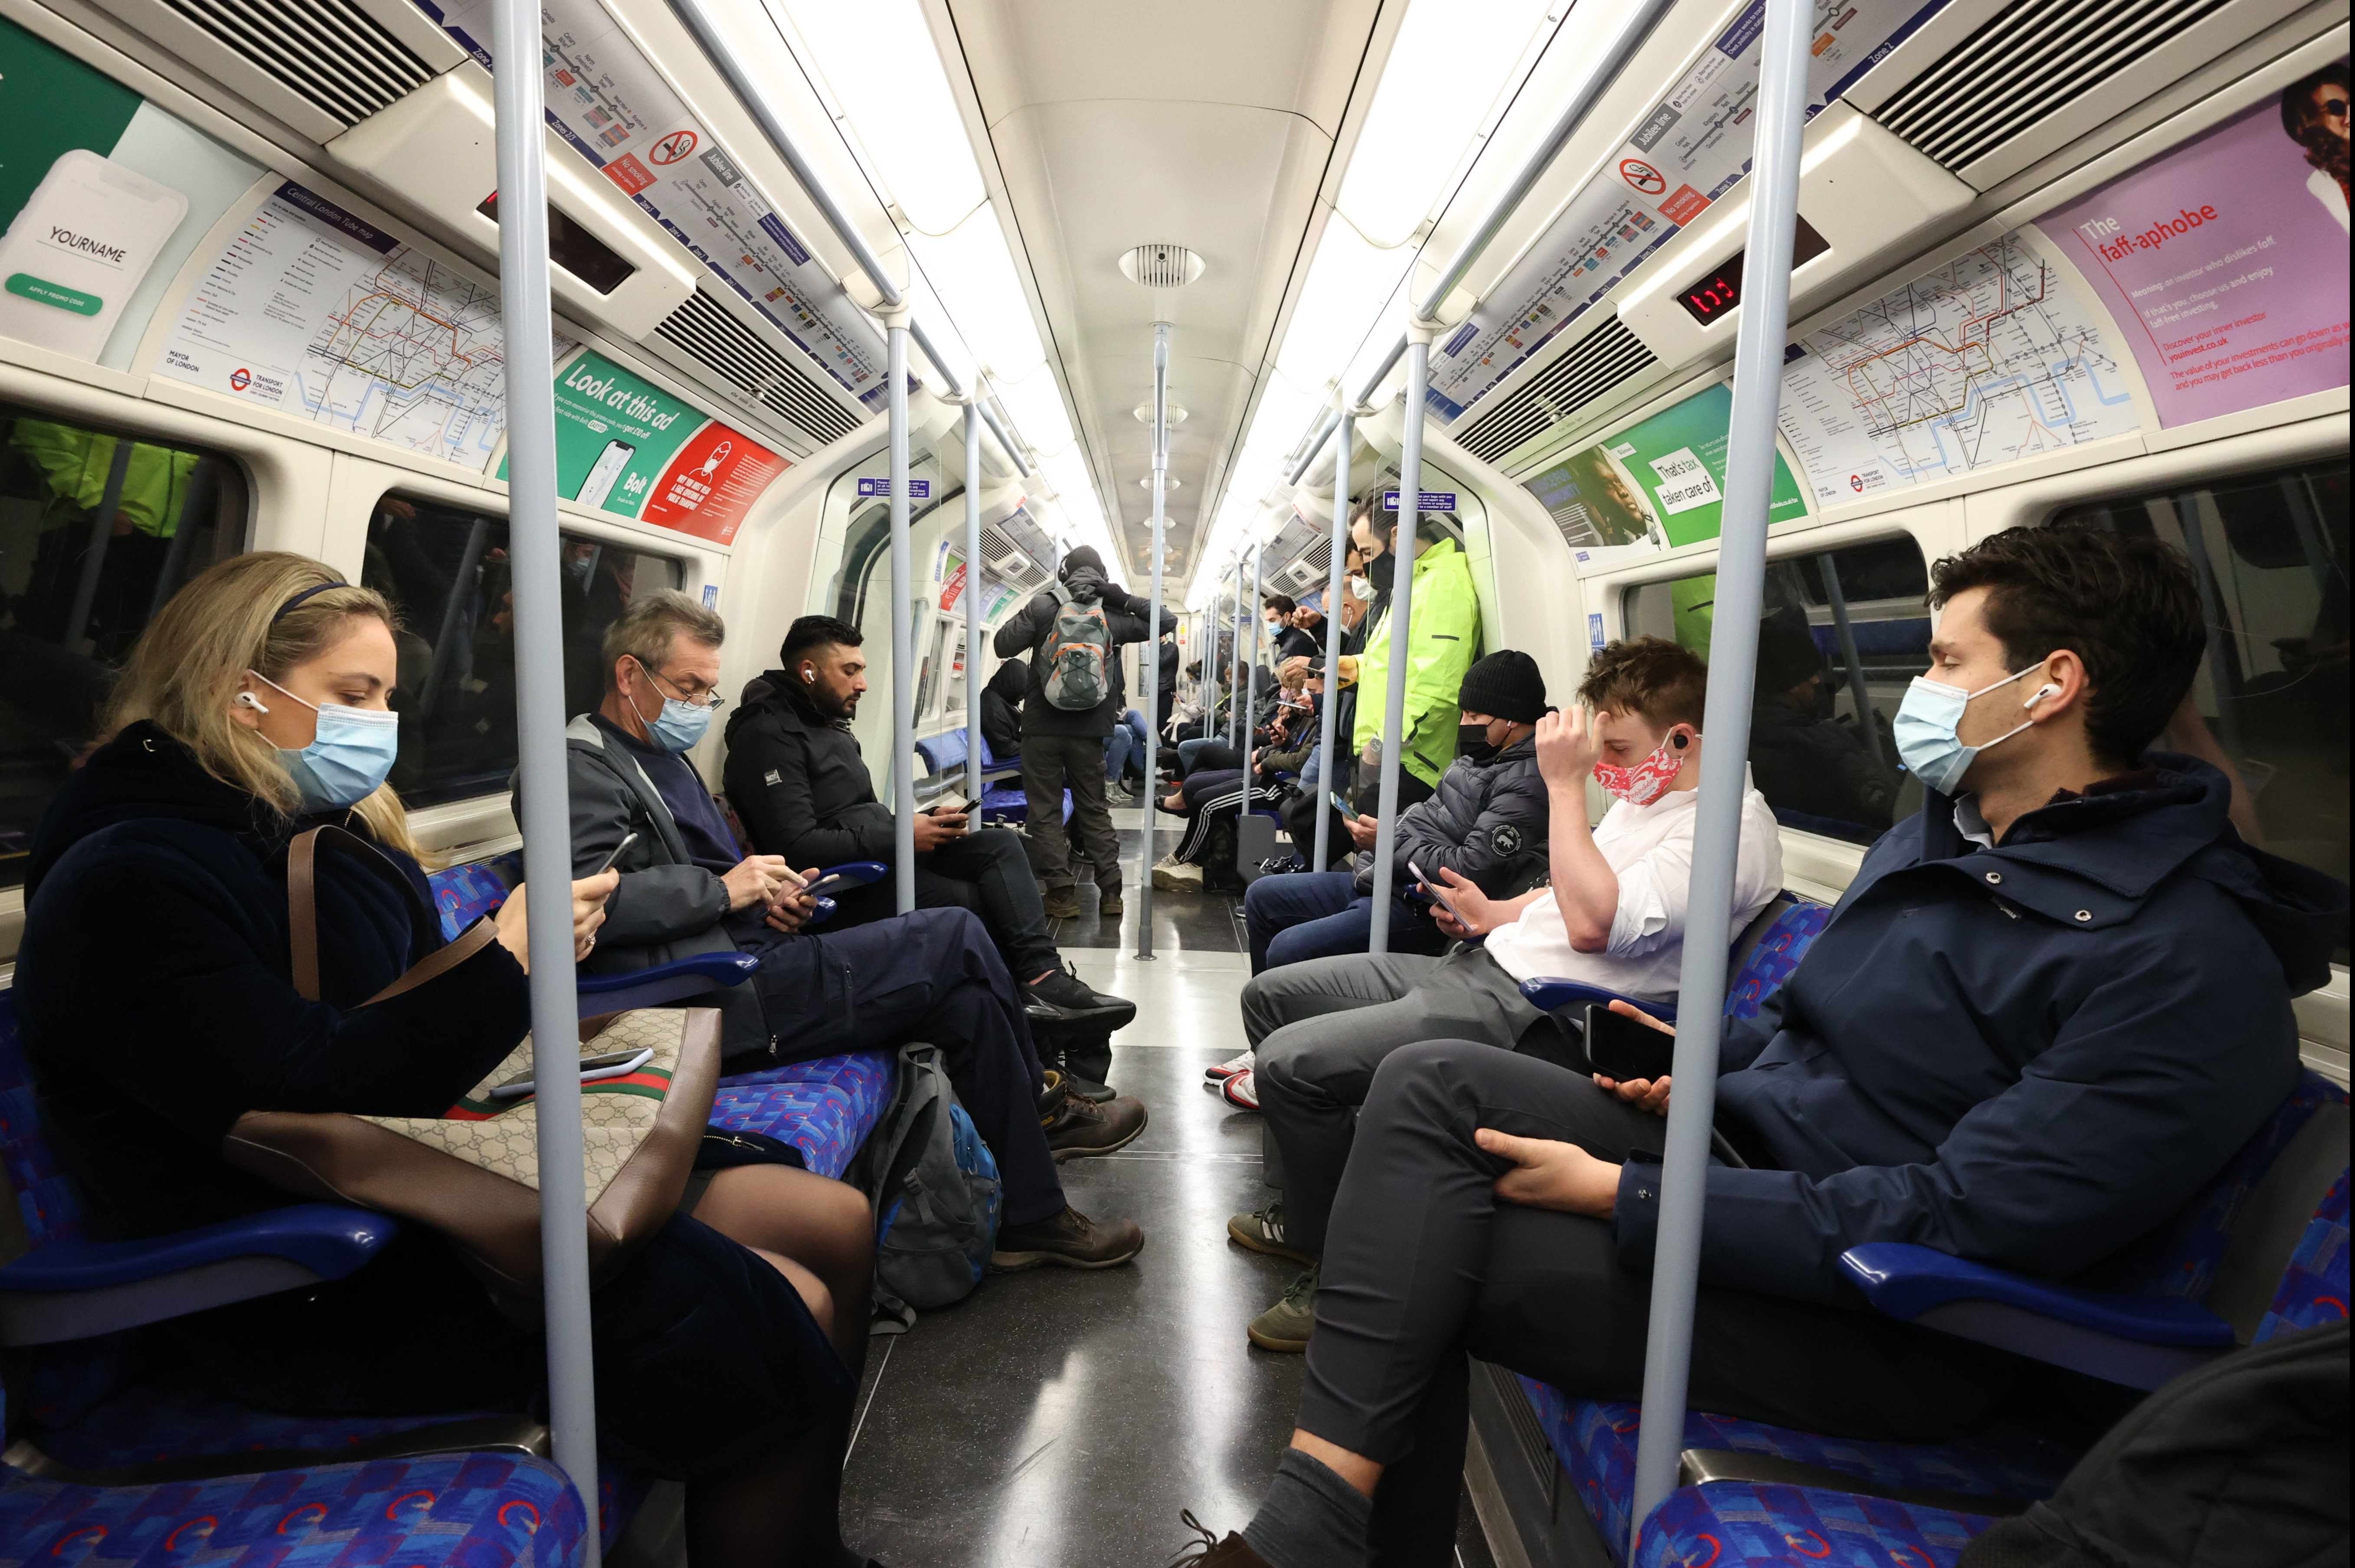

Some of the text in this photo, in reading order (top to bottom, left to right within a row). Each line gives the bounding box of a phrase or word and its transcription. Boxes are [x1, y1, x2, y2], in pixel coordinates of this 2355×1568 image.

[542, 9, 556, 23] Canada
[558, 36, 573, 48] Wharf
[564, 33, 576, 45] Canary
[1722, 29, 1743, 50] Improvement
[1741, 19, 1752, 30] works
[1728, 30, 1753, 54] Check publicity
[472, 48, 490, 63] Zone
[584, 54, 595, 65] North
[1868, 42, 1894, 63] Zone 2
[575, 55, 592, 73] Greenwich
[598, 79, 607, 89] Town
[602, 74, 615, 88] Canning
[1735, 81, 1751, 95] Neasden
[613, 95, 628, 110] West Ham
[1712, 93, 1729, 107] Wembley
[1703, 112, 1720, 126] Kingsbury
[552, 119, 576, 141] Zones 2/3
[1638, 112, 1671, 146] Jubilee line
[1675, 136, 1687, 147] Canons
[1706, 132, 1725, 149] Queensbury
[620, 159, 649, 186] No smoking
[707, 154, 733, 181] Jubilee line
[1715, 183, 1728, 194] Zone
[639, 200, 649, 209] Zone
[1665, 190, 1695, 215] No smoking
[287, 188, 316, 207] Central
[314, 202, 342, 221] London
[341, 218, 358, 231] Tube
[358, 229, 373, 239] map
[669, 226, 679, 236] Zone
[2080, 217, 2121, 239] The
[2099, 205, 2218, 262] faff-aphobe
[50, 226, 126, 262] YOURNAME
[693, 248, 702, 256] Zone
[1639, 249, 1652, 260] Zones
[2131, 282, 2165, 299] Meaning:
[2175, 267, 2204, 283] investor
[2205, 259, 2223, 271] who
[2224, 245, 2257, 264] dislikes
[29, 286, 69, 302] APPLY PROMO
[2151, 303, 2173, 317] that's
[2172, 298, 2190, 310] you,
[2189, 288, 2218, 303] choose
[2218, 284, 2229, 292] us
[2230, 274, 2247, 288] and
[2247, 266, 2273, 281] enjoy
[2150, 301, 2219, 329] faff-free investing.
[2163, 312, 2267, 351] Discover your inner investor
[169, 350, 189, 361] MAYOR
[2169, 337, 2228, 364] youinvest.co.uk
[2170, 371, 2184, 379] The
[2185, 365, 2204, 376] value
[2205, 360, 2212, 369] of
[2213, 356, 2230, 369] your
[2231, 343, 2279, 362] investments
[2280, 338, 2294, 347] can
[2296, 335, 2306, 345] go
[2306, 328, 2330, 340] down
[2332, 324, 2342, 333] as
[175, 359, 199, 372] LONDON
[2175, 380, 2189, 390] and
[2189, 377, 2203, 388] you
[2204, 372, 2219, 381] may
[2221, 368, 2233, 379] get
[2232, 362, 2252, 374] back
[2252, 359, 2268, 368] less
[2268, 353, 2288, 363] than
[2288, 348, 2305, 359] you
[2306, 336, 2342, 353] originally
[256, 375, 283, 387] TRANSPORT
[263, 385, 283, 395] LONDON
[564, 364, 680, 431] Look at this ad
[571, 402, 589, 414] memorise
[632, 428, 644, 436] £10
[1657, 459, 1700, 479] That's tax
[623, 472, 648, 494] Bolt
[674, 484, 686, 495] FACE
[1662, 476, 1714, 505] taken care of
[1492, 825, 1520, 837] Authentic Down
